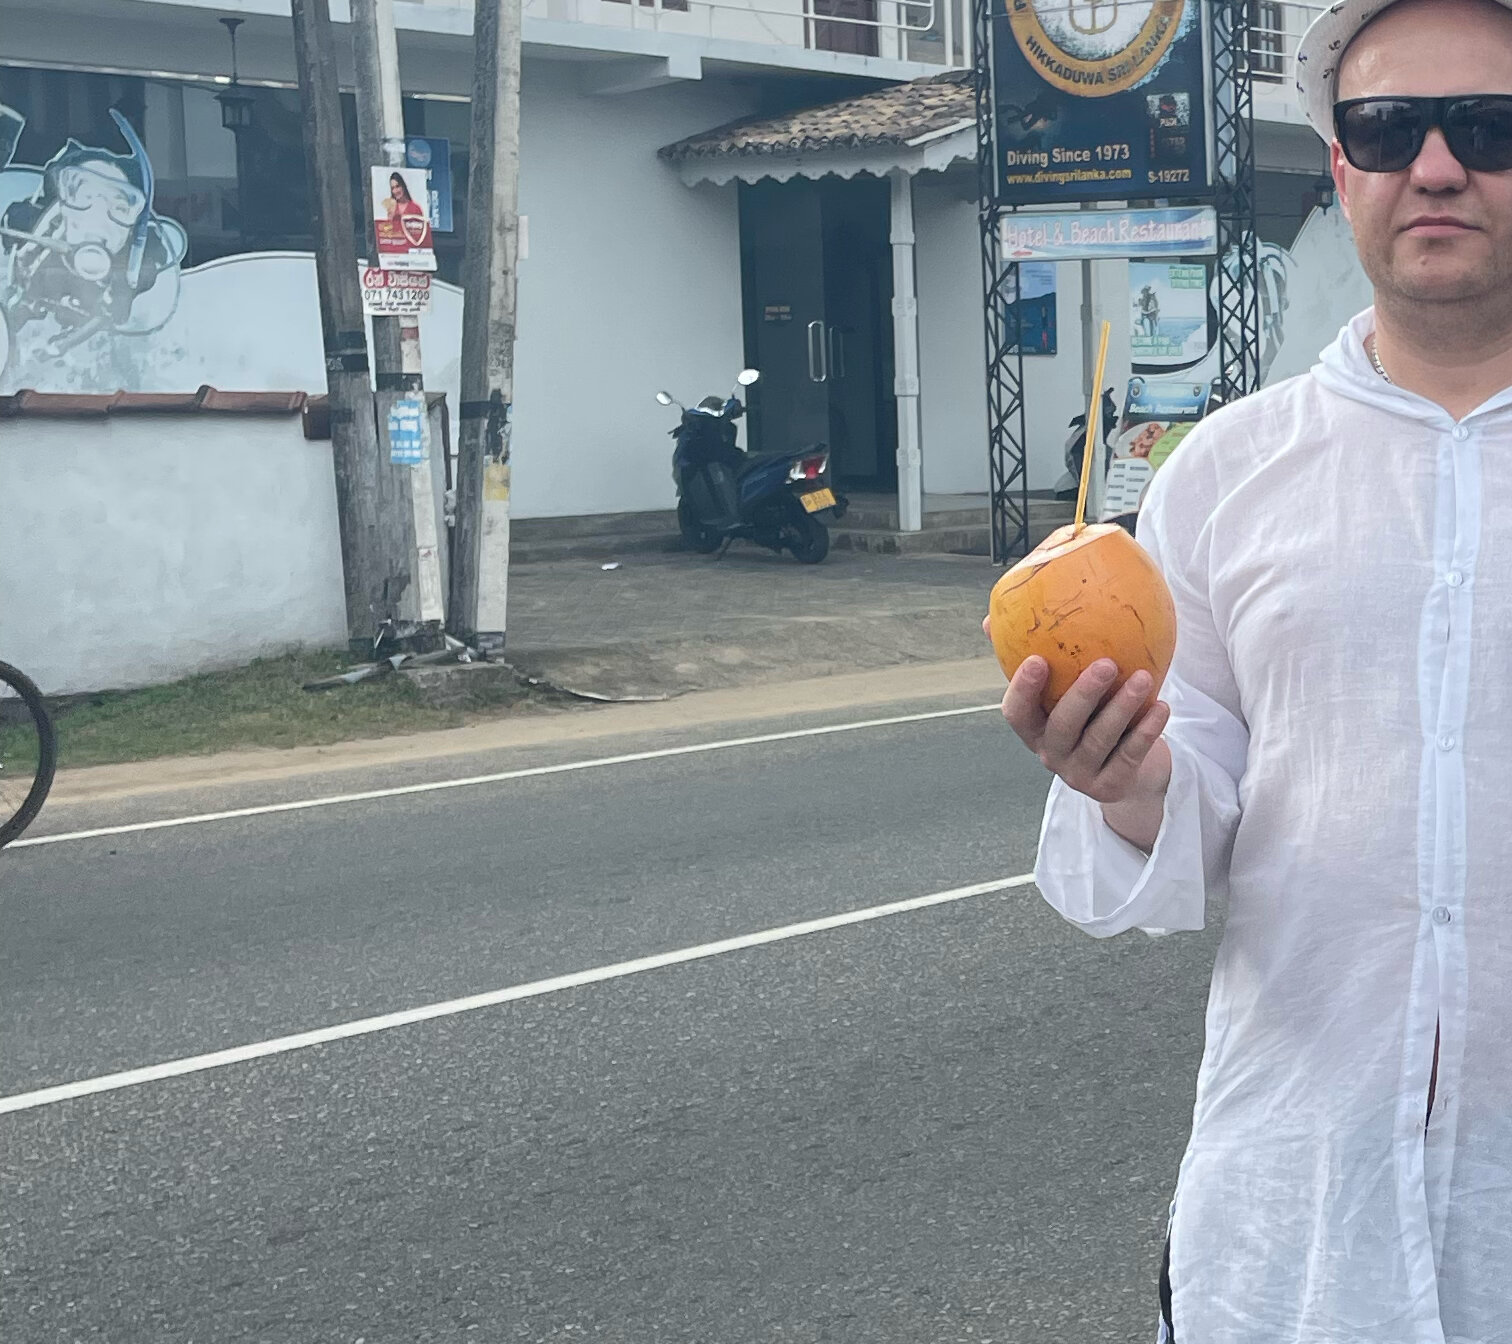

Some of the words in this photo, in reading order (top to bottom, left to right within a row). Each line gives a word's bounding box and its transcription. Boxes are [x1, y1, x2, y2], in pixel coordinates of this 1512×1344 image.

[1025, 35, 1105, 86] HIKKADUWA
[1107, 64, 1131, 81] SRI
[1007, 150, 1048, 167] Diving
[1052, 147, 1091, 163] Since
[1095, 144, 1130, 160] 1973
[1006, 169, 1132, 184] www.divingsrilanka.com
[1148, 169, 1190, 184] S-19272
[1007, 222, 1048, 248] Hotel
[1053, 222, 1065, 246] &
[1070, 219, 1115, 244] Beach
[1119, 216, 1209, 242] Restaurant
[365, 290, 382, 301] 071
